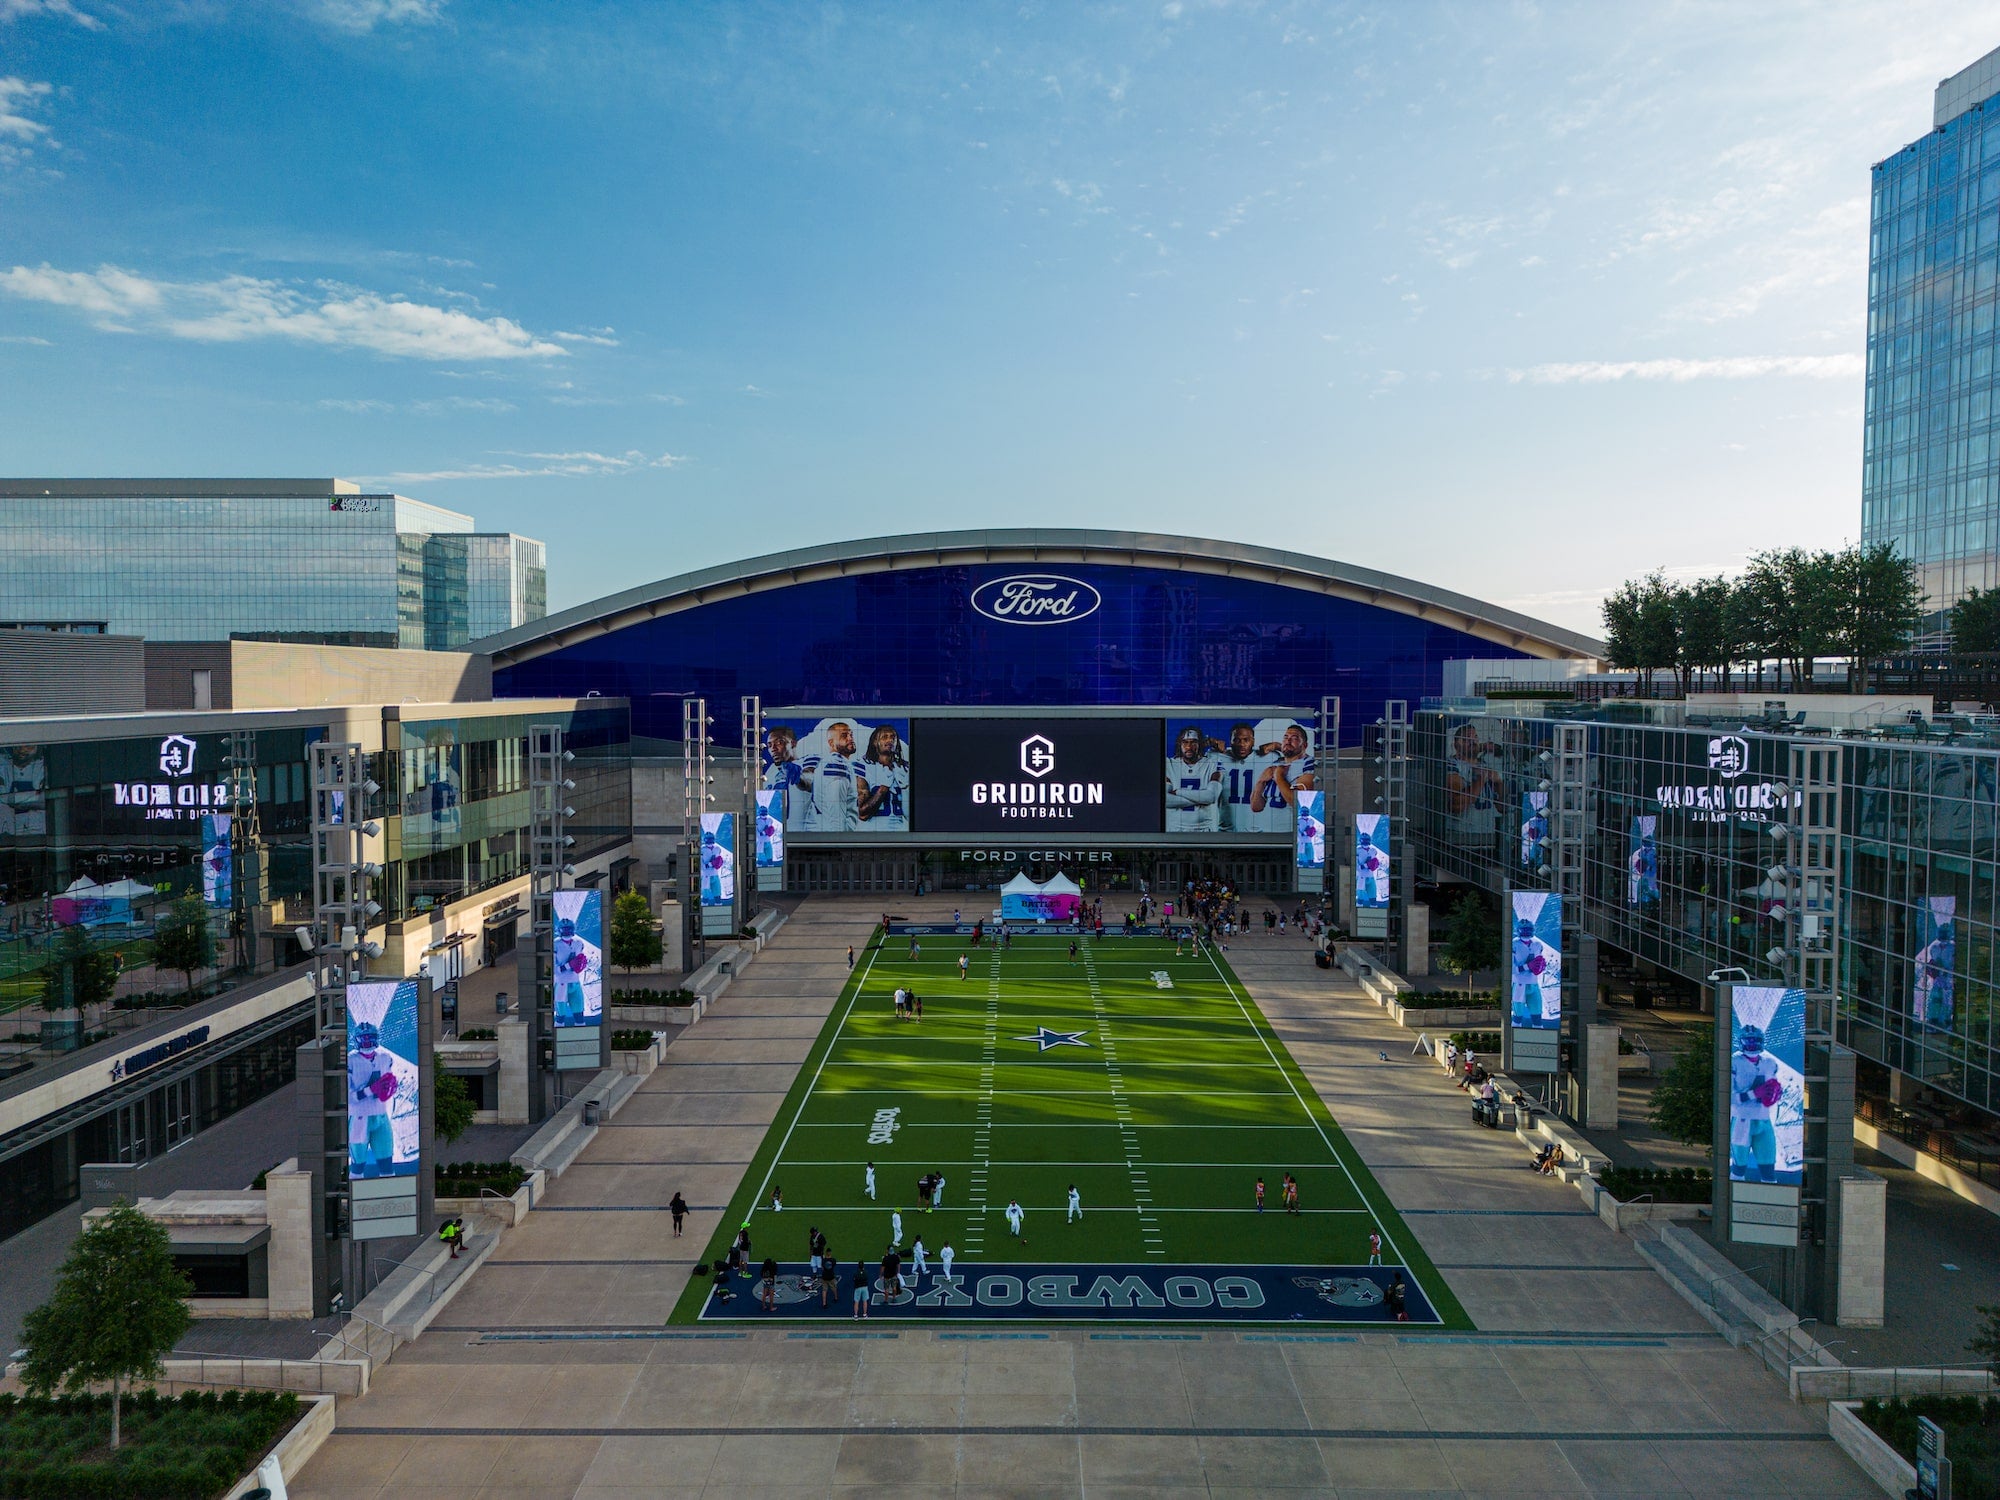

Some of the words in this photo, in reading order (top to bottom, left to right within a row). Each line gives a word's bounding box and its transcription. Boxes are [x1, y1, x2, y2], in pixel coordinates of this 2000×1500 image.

[994, 581, 1078, 615] Ford
[972, 783, 1103, 804] GRIDIRON
[1228, 768, 1253, 804] 11
[1001, 807, 1074, 818] FOOTBALL
[960, 851, 1017, 862] FORD
[1029, 851, 1113, 862] CENTER
[871, 1274, 1265, 1309] COWBOYS
